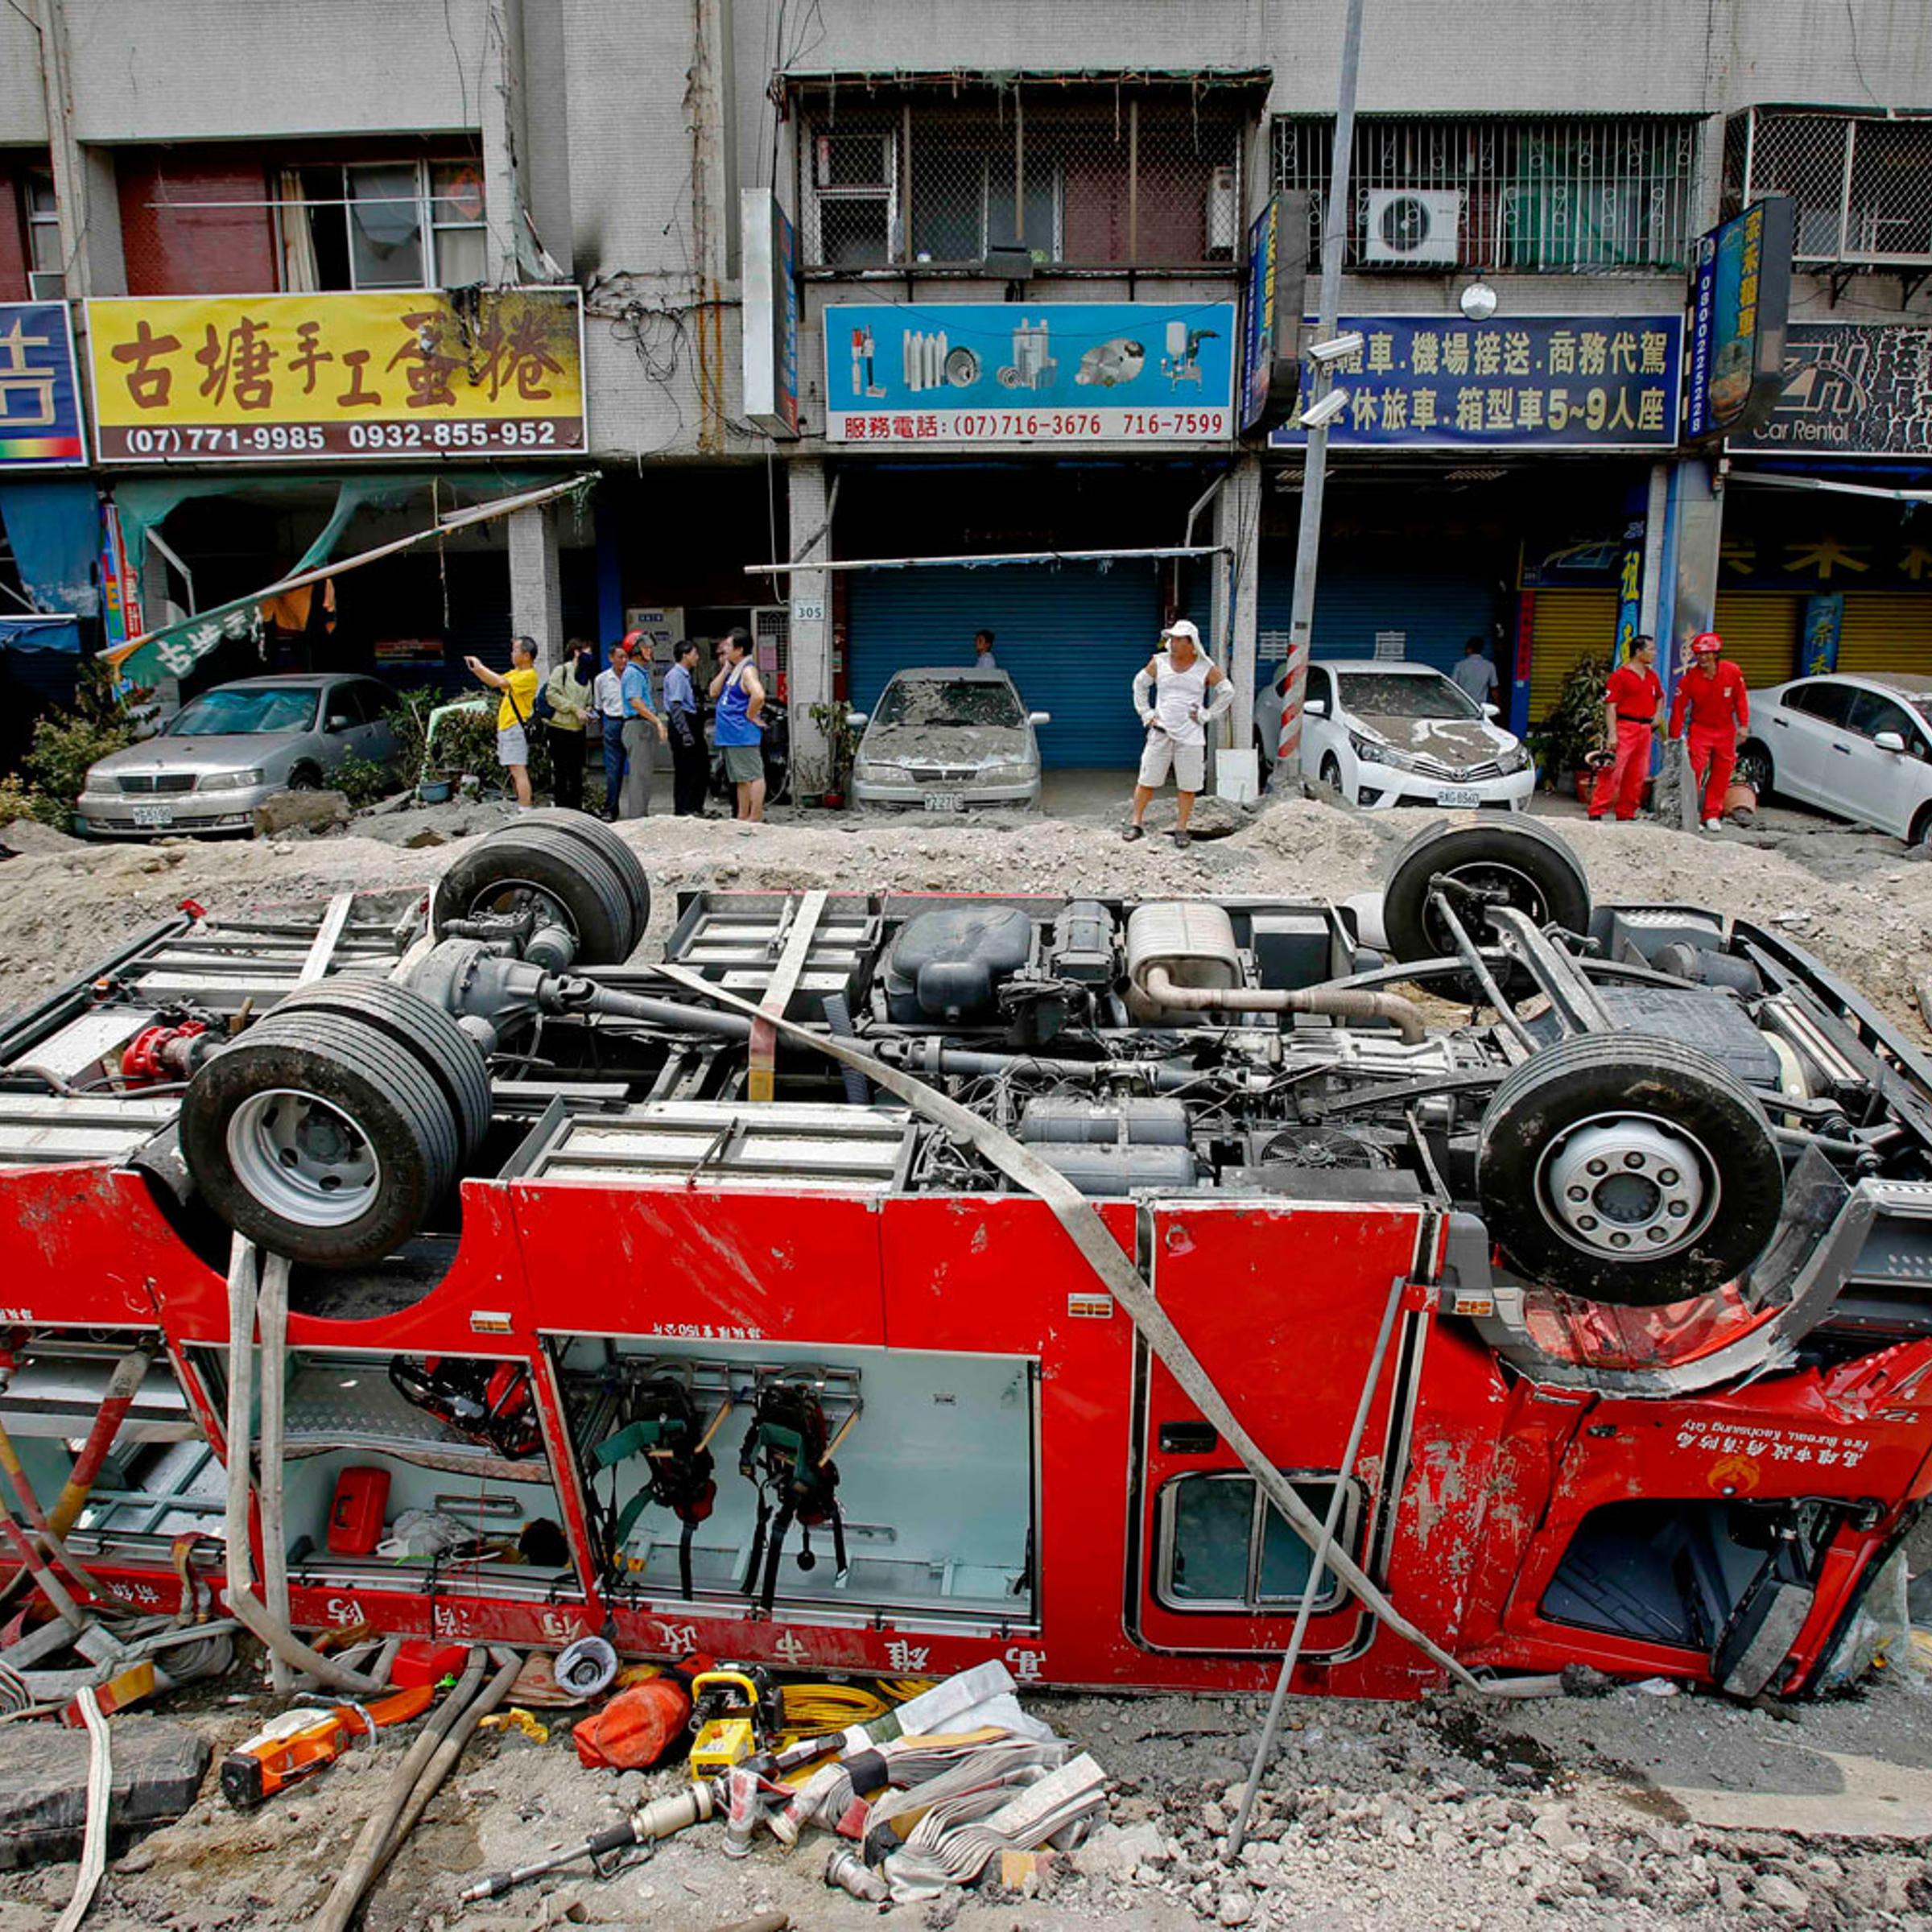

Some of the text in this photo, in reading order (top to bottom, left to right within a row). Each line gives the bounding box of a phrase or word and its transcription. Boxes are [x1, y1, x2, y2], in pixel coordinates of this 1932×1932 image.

[1124, 414, 1224, 436] 716-7599
[1792, 419, 1850, 441] Rental
[126, 422, 555, 453] (07)771-9985 0932-855-952
[798, 606, 822, 619] 305
[1680, 1418, 1707, 1433] City
[1711, 1421, 1781, 1440] Kaohsiung
[1675, 1431, 1864, 1468] 高雄市政府消防局
[1843, 1438, 1869, 1451] Fire
